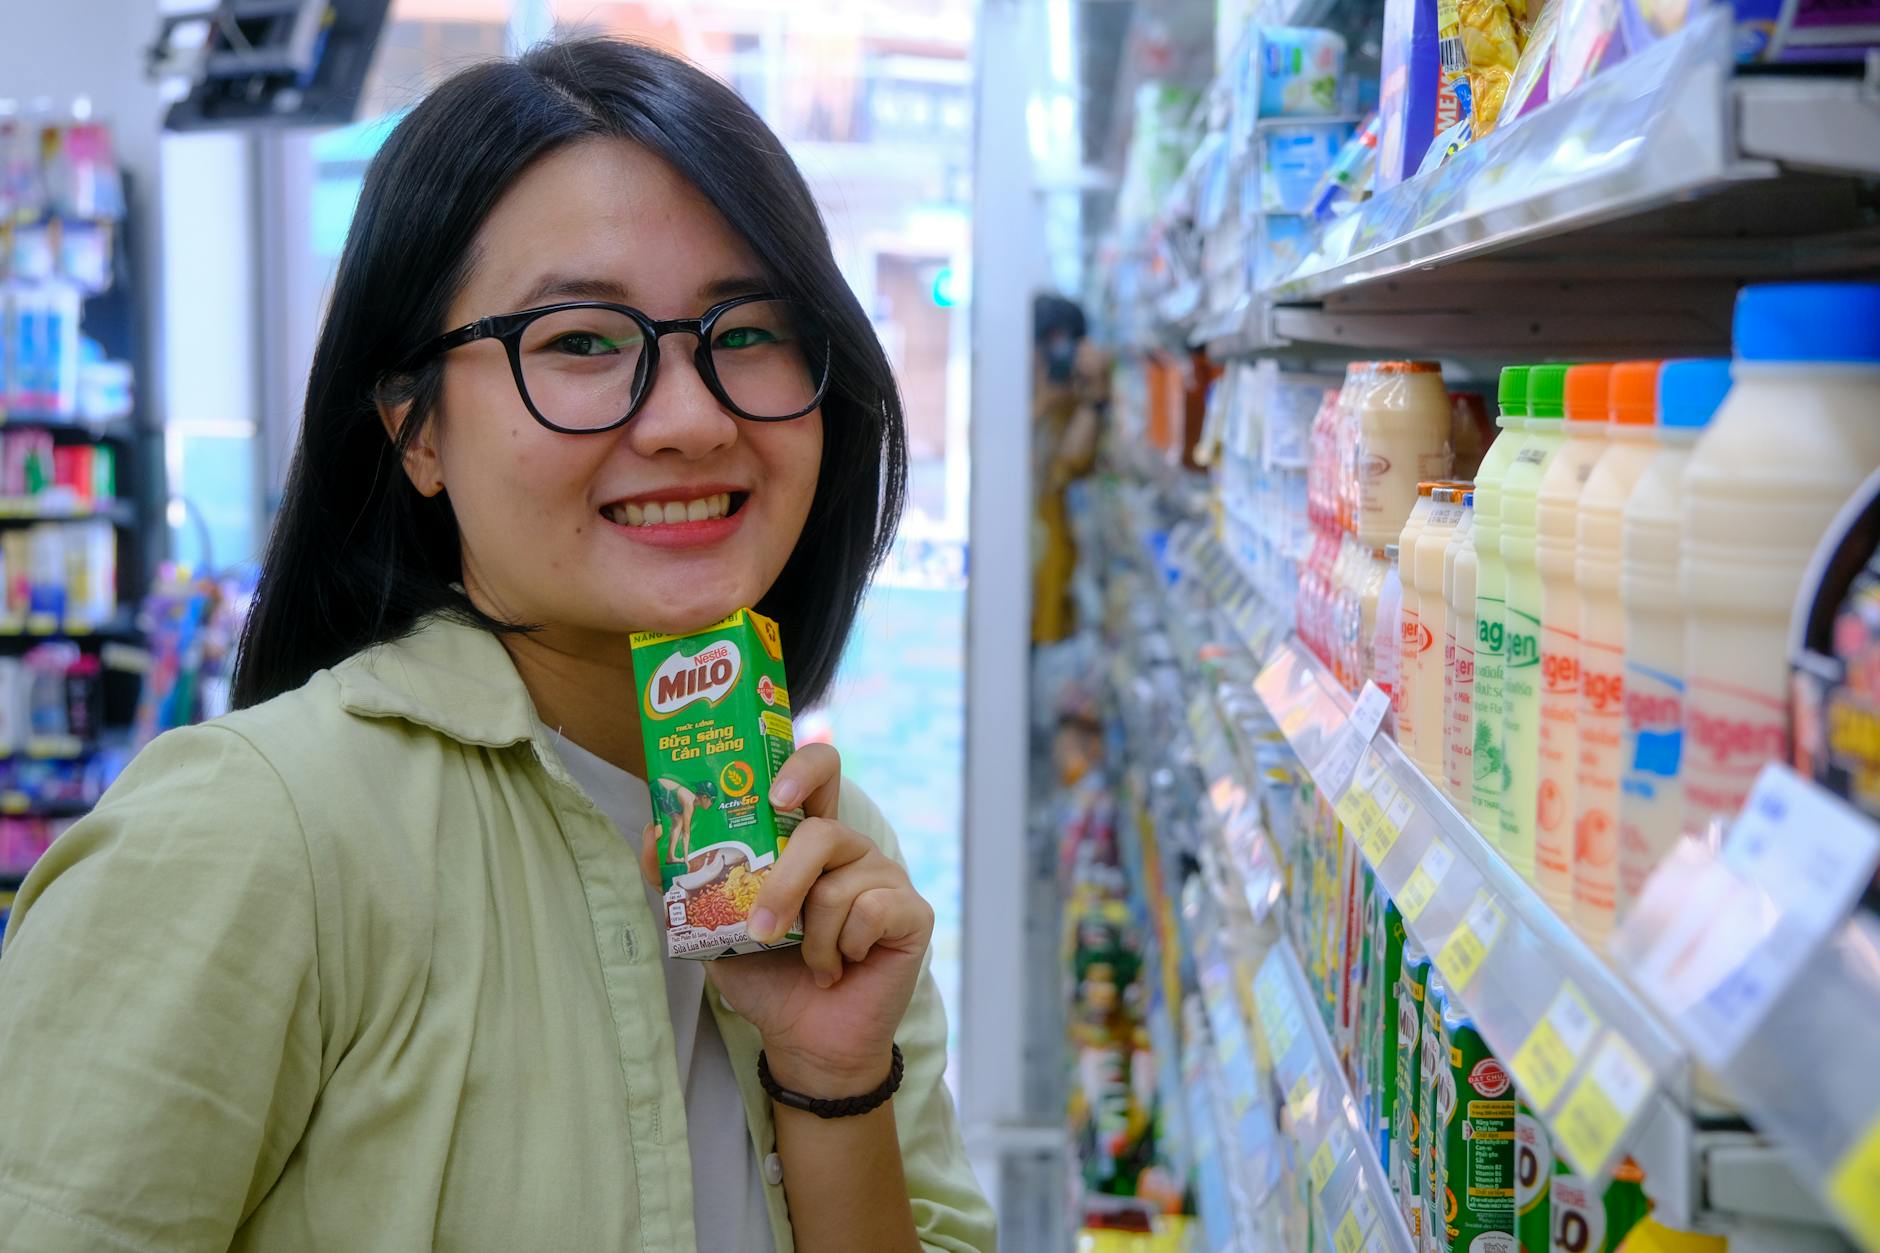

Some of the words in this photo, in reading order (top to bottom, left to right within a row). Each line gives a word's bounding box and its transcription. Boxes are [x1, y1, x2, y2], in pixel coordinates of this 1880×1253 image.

[1475, 618, 1504, 651] ag
[693, 646, 728, 666] Nestlé
[657, 658, 733, 704] MILO
[659, 734, 691, 750] Bữa
[696, 726, 734, 743] sáng
[671, 746, 700, 761] Cân
